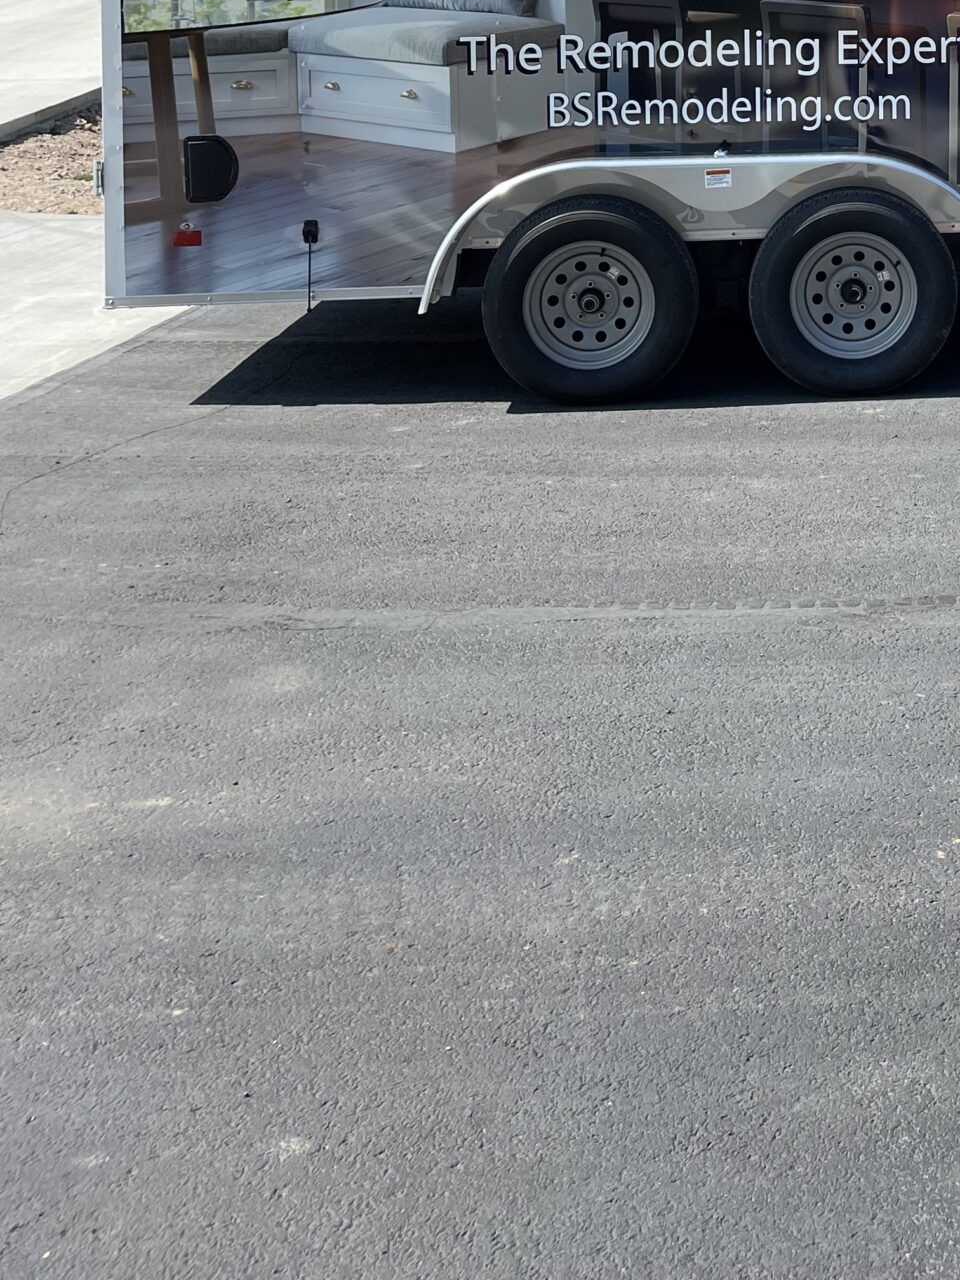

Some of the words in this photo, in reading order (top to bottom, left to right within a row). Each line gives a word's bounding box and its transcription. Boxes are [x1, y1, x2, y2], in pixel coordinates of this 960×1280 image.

[460, 35, 542, 72] The
[560, 30, 821, 76] Remodeling
[549, 87, 911, 131] BSRemodeling.com
